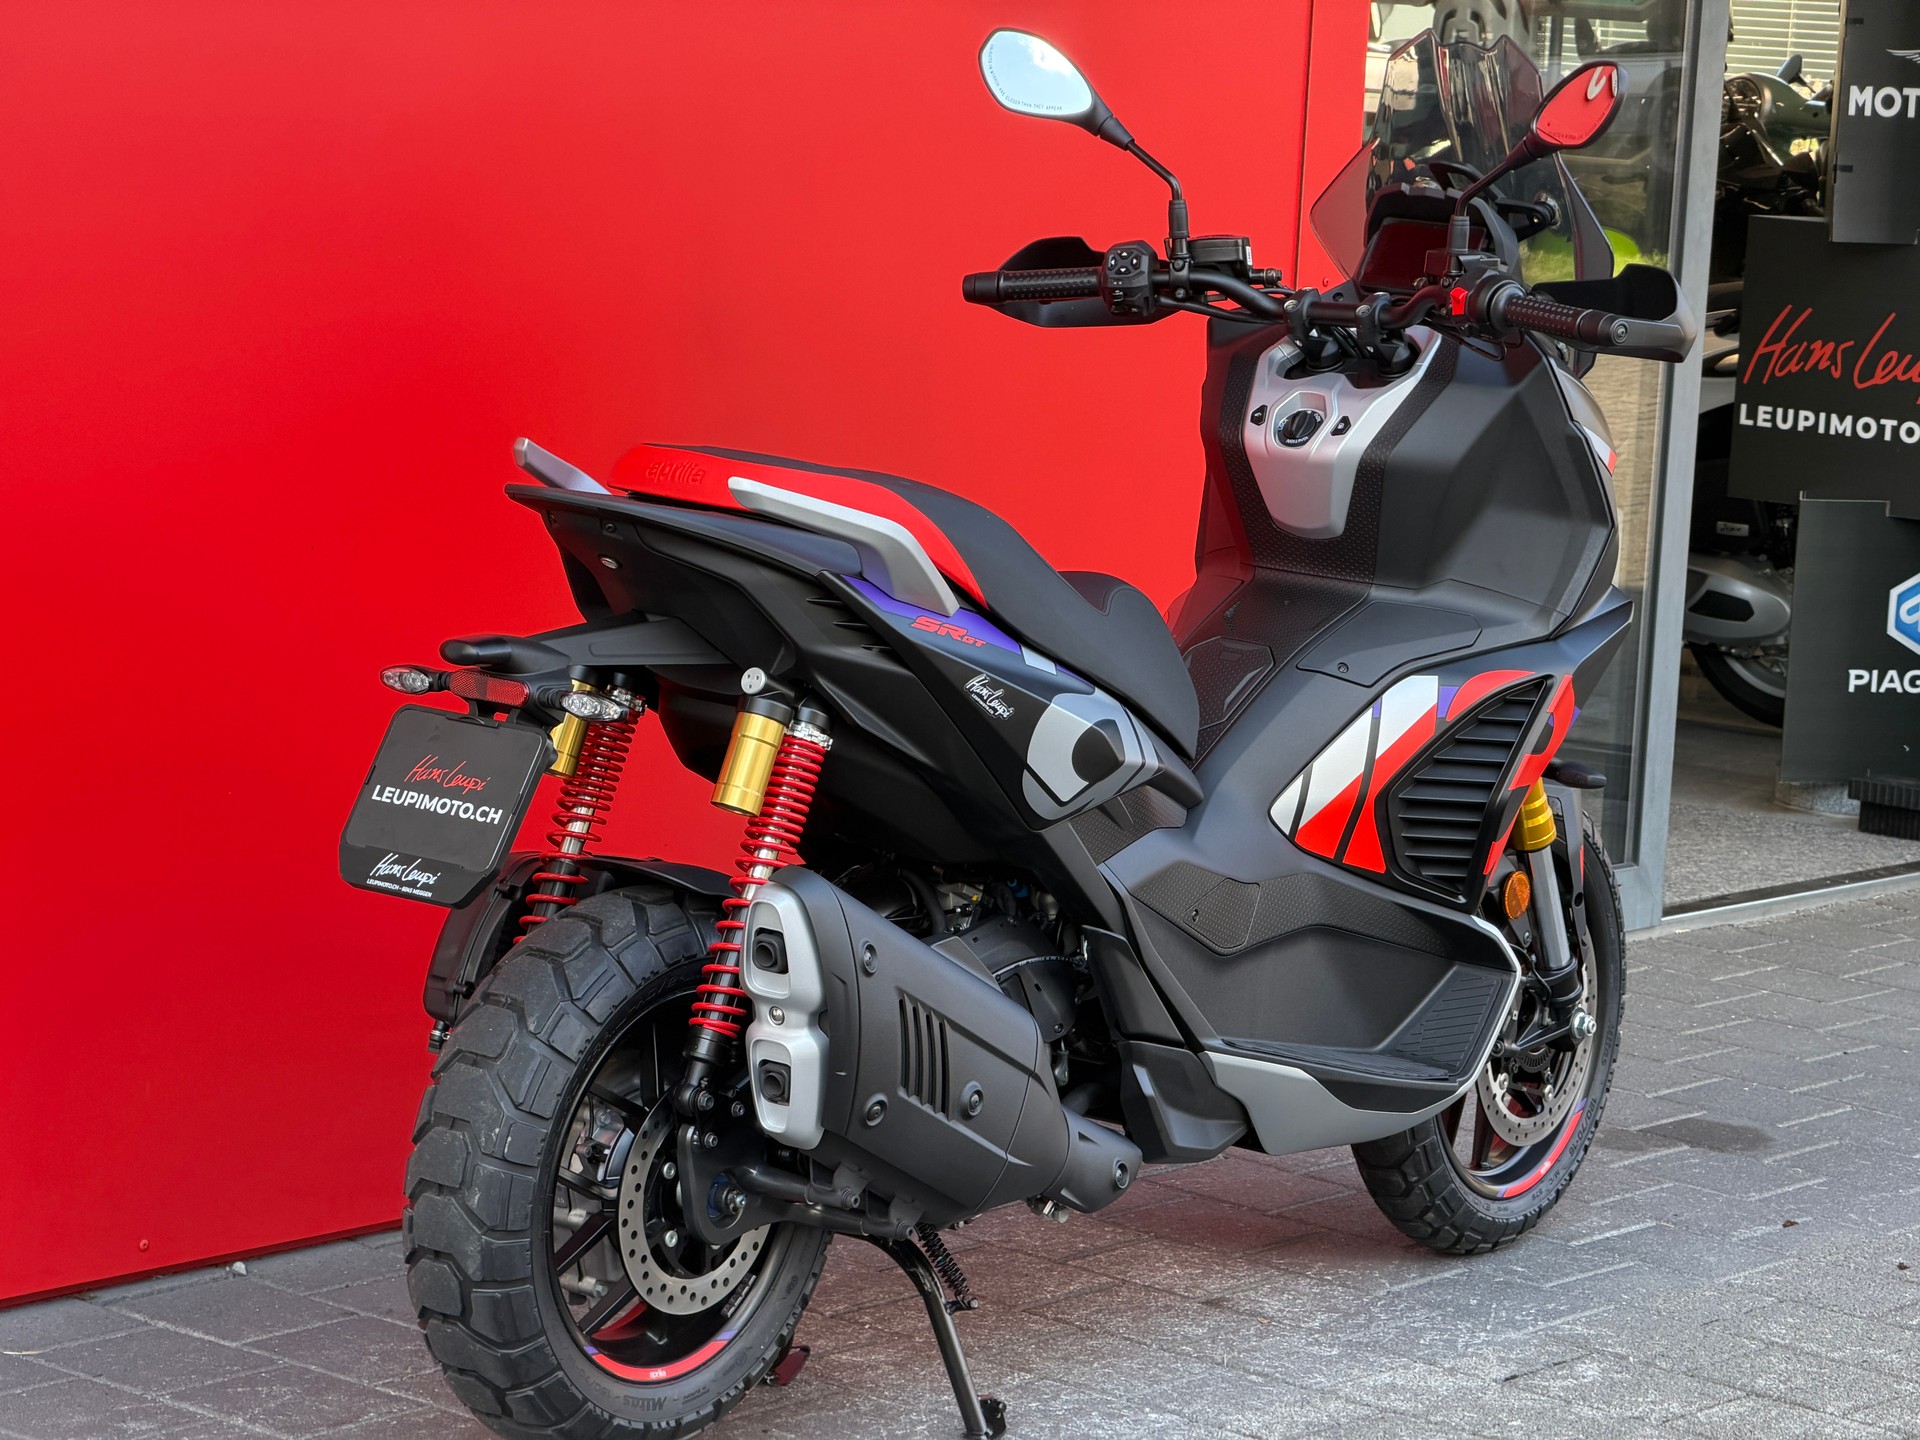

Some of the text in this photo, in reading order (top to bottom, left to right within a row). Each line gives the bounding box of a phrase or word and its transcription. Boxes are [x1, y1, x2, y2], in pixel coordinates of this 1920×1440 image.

[1742, 303, 1855, 385] Hans
[645, 461, 705, 485] aprilia
[966, 676, 1013, 718] Hans Leupi
[404, 754, 491, 795] Hans Leupi
[371, 784, 503, 825] LEUPIMOTO.CH
[369, 852, 442, 887] Hans Leupi
[412, 888, 433, 898] MEGGEN
[622, 1394, 667, 1411] Mitas
